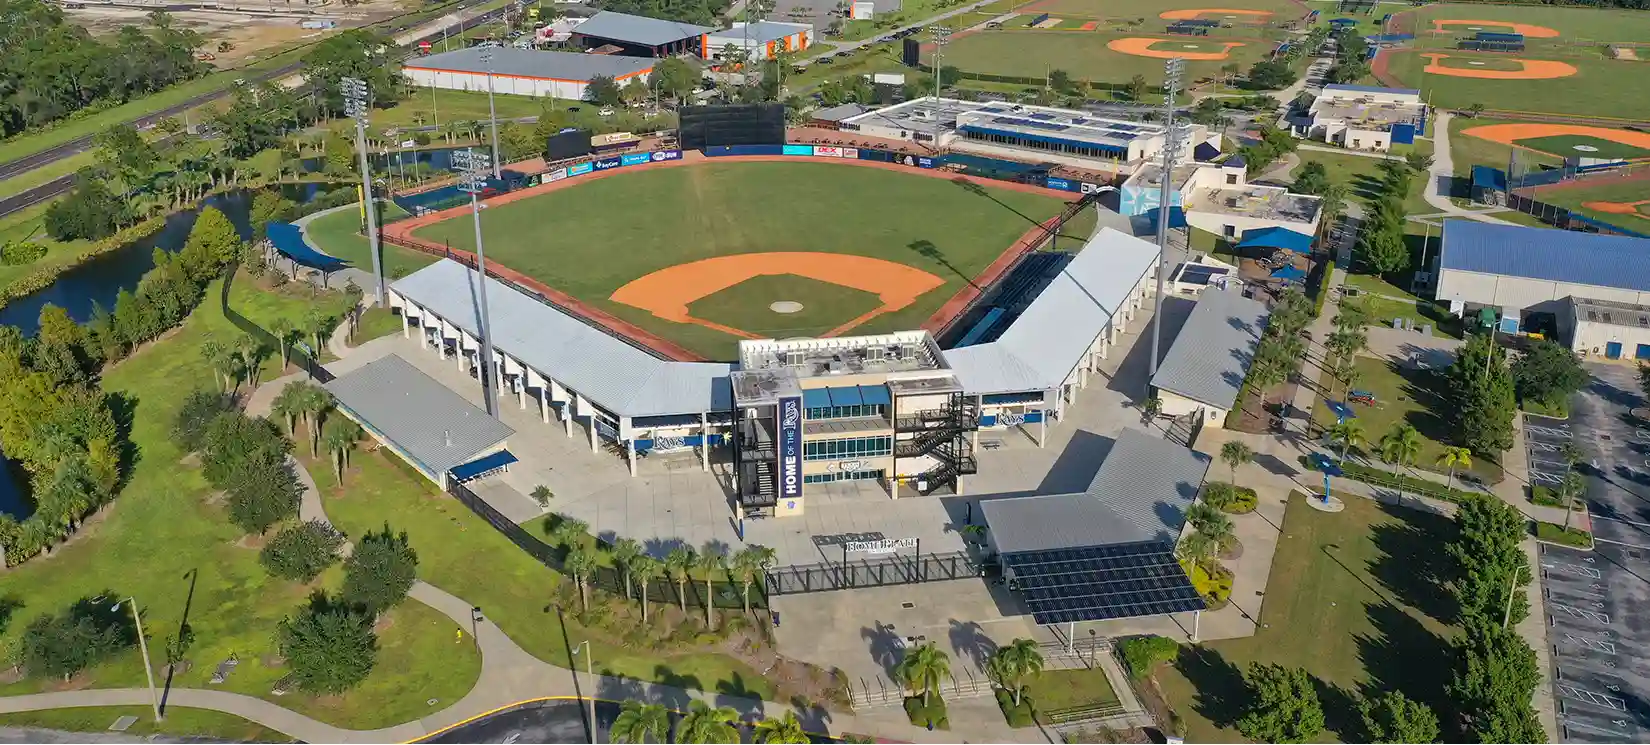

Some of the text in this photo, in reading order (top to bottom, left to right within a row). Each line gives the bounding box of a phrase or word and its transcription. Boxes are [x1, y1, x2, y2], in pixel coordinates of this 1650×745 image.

[787, 430, 795, 444] THE
[787, 446, 795, 456] OF
[786, 456, 796, 494] HOME
